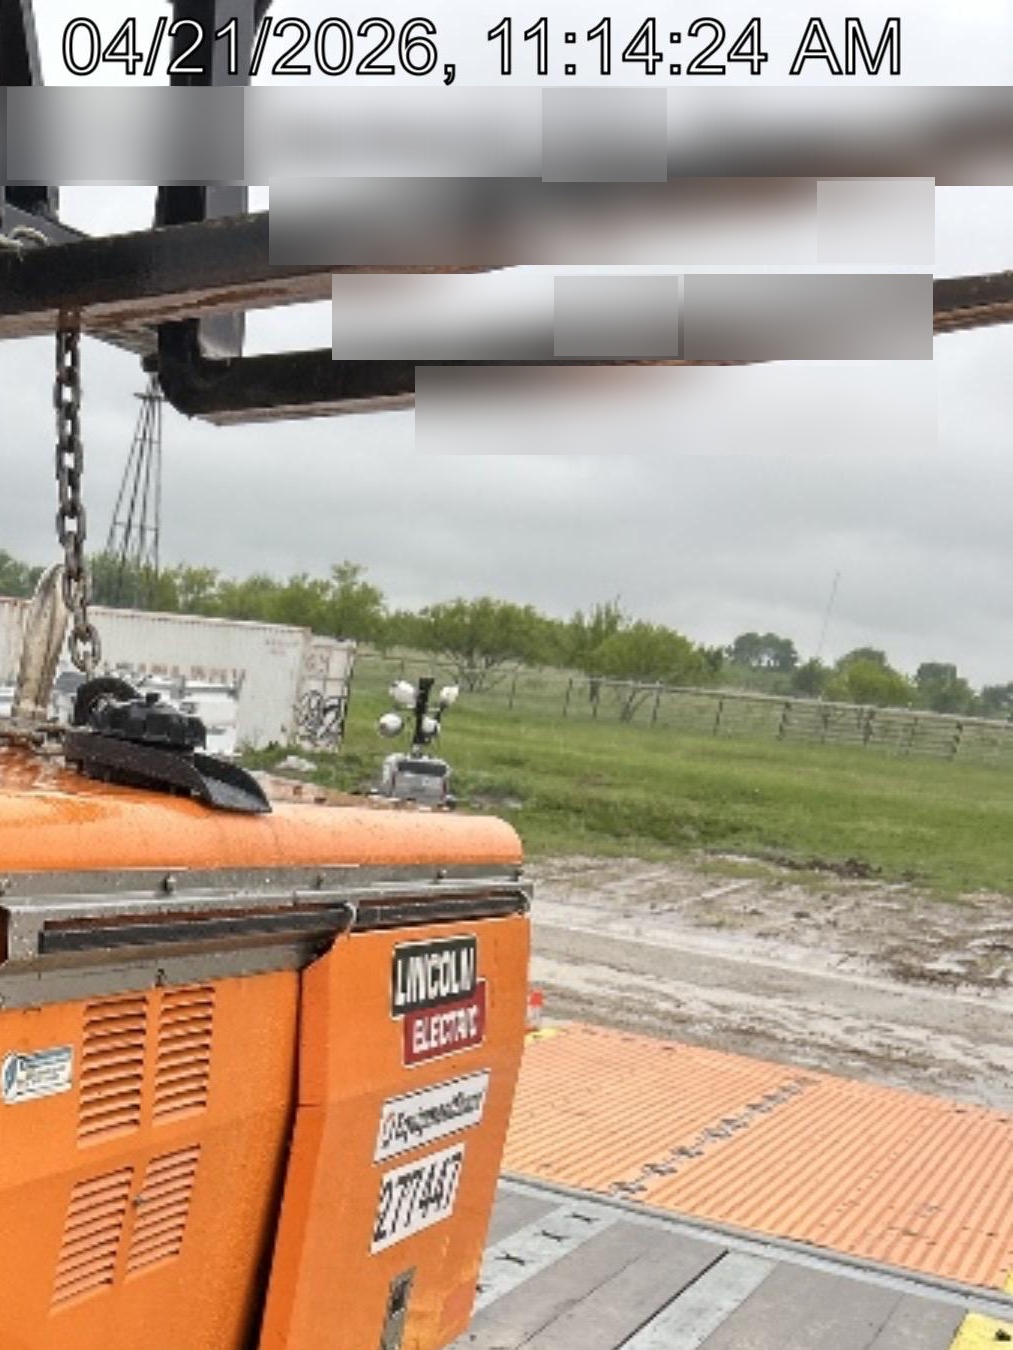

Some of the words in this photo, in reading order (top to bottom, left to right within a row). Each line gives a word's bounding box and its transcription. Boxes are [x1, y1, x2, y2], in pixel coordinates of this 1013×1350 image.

[395, 946, 475, 1006] LINCOLN
[412, 1006, 479, 1054] ELECTRIC
[373, 1150, 465, 1243] 277447
